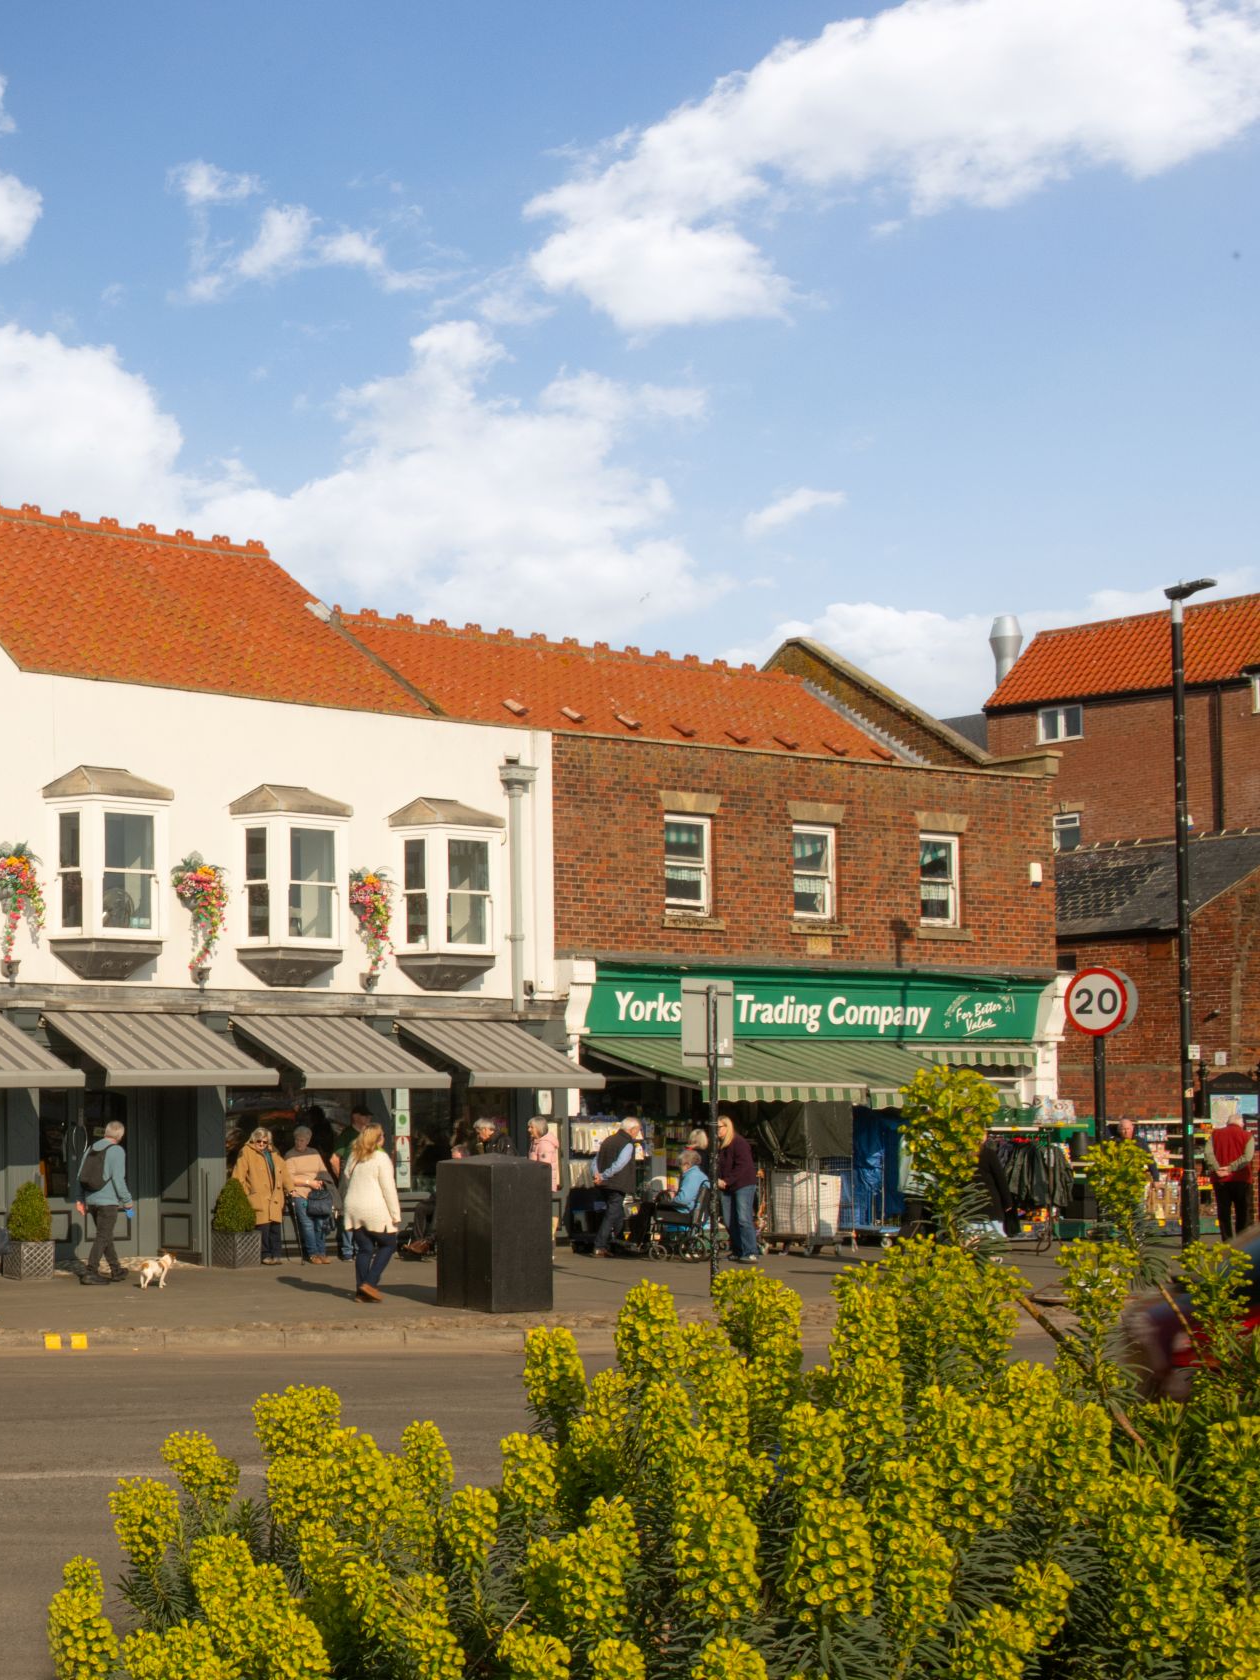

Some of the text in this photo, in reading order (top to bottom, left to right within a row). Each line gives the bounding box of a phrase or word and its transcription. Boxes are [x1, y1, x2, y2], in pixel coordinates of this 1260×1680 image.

[956, 1001, 1002, 1023] For Better
[1075, 988, 1118, 1014] 20
[736, 994, 822, 1033] Trading
[827, 997, 931, 1034] Company
[966, 1016, 994, 1032] Value
